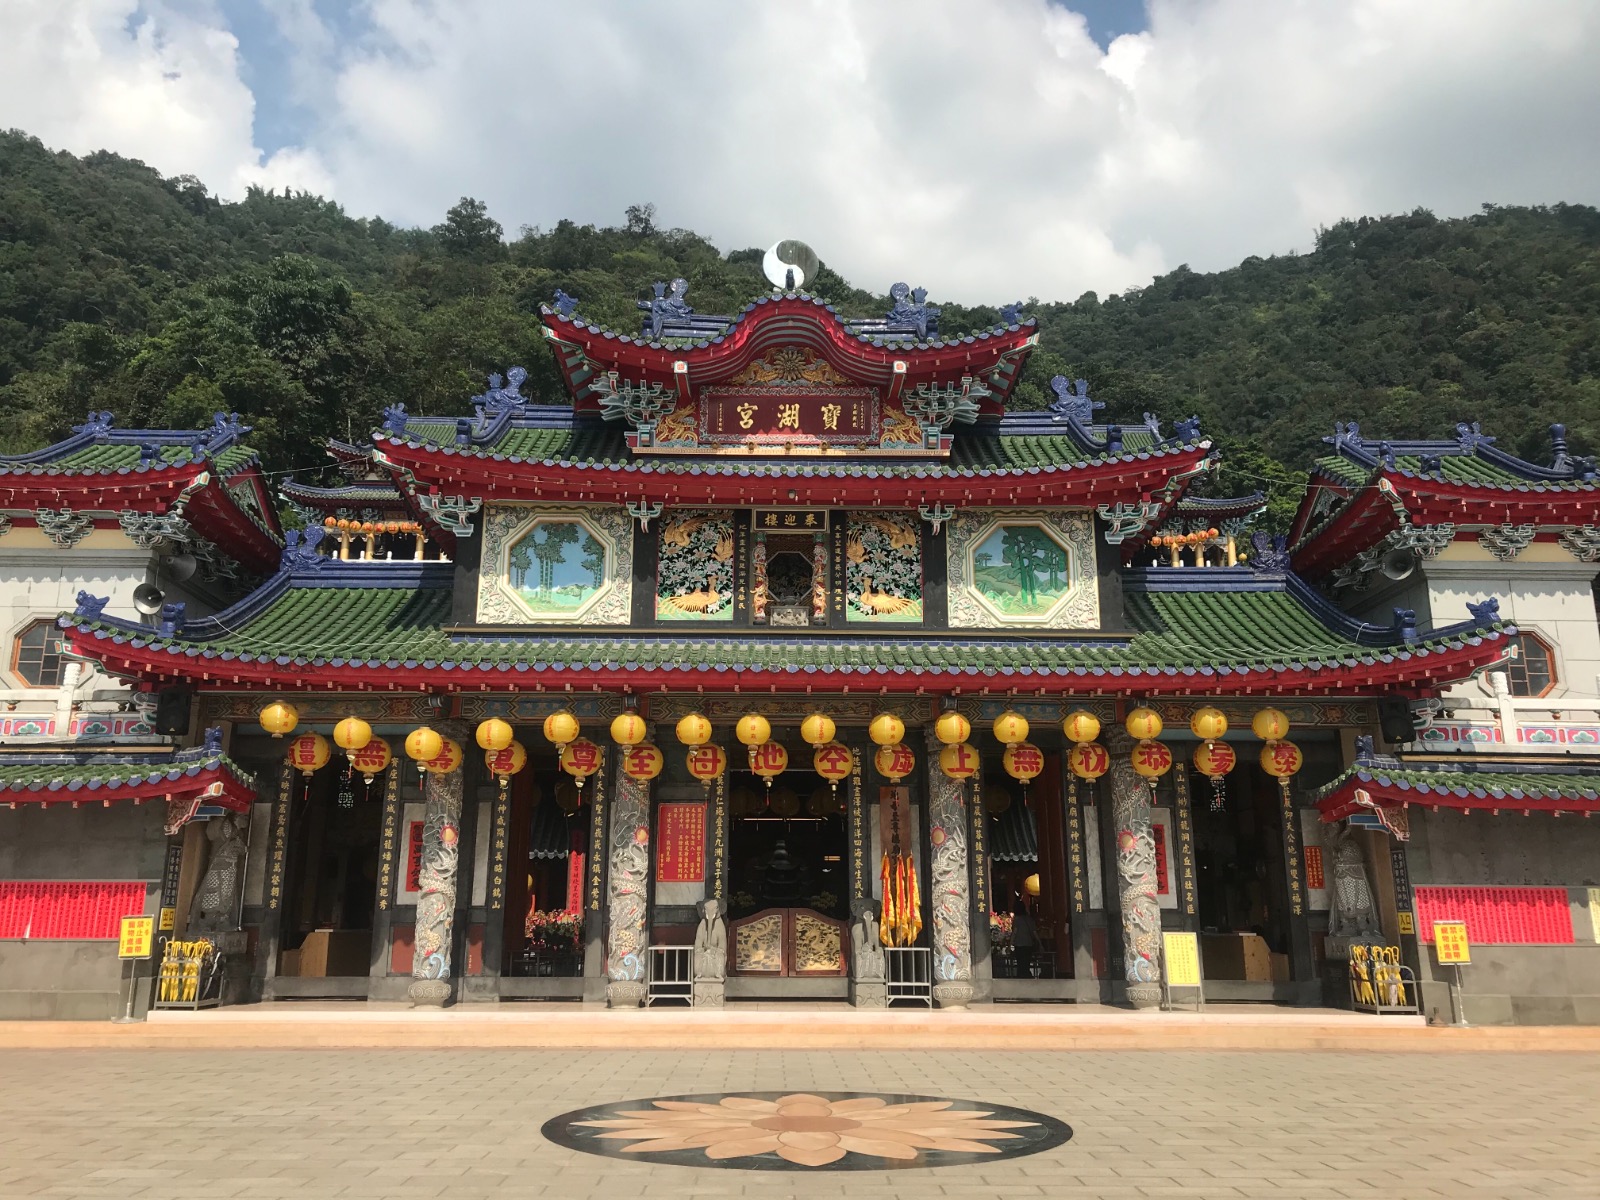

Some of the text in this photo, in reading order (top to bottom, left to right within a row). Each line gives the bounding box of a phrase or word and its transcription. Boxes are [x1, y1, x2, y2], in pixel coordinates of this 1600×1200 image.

[736, 402, 843, 431] 寶湖宮
[764, 513, 818, 527] 奉迎樓
[353, 740, 386, 767] 無
[488, 743, 516, 772] 萬
[567, 742, 598, 773] 尊
[629, 746, 657, 776] 至
[689, 746, 722, 775] 母
[754, 743, 789, 770] 地
[818, 745, 850, 775] 空
[889, 744, 915, 774] 虛
[947, 744, 975, 773] 上
[1010, 745, 1042, 773] 無
[1077, 744, 1107, 774] 祝
[1137, 744, 1171, 771] 恭
[1207, 742, 1234, 774] 己亥
[1273, 743, 1299, 774] 歲次
[491, 784, 509, 910] 母神威顯赫長昭白鶴山
[1400, 915, 1412, 926] 入口
